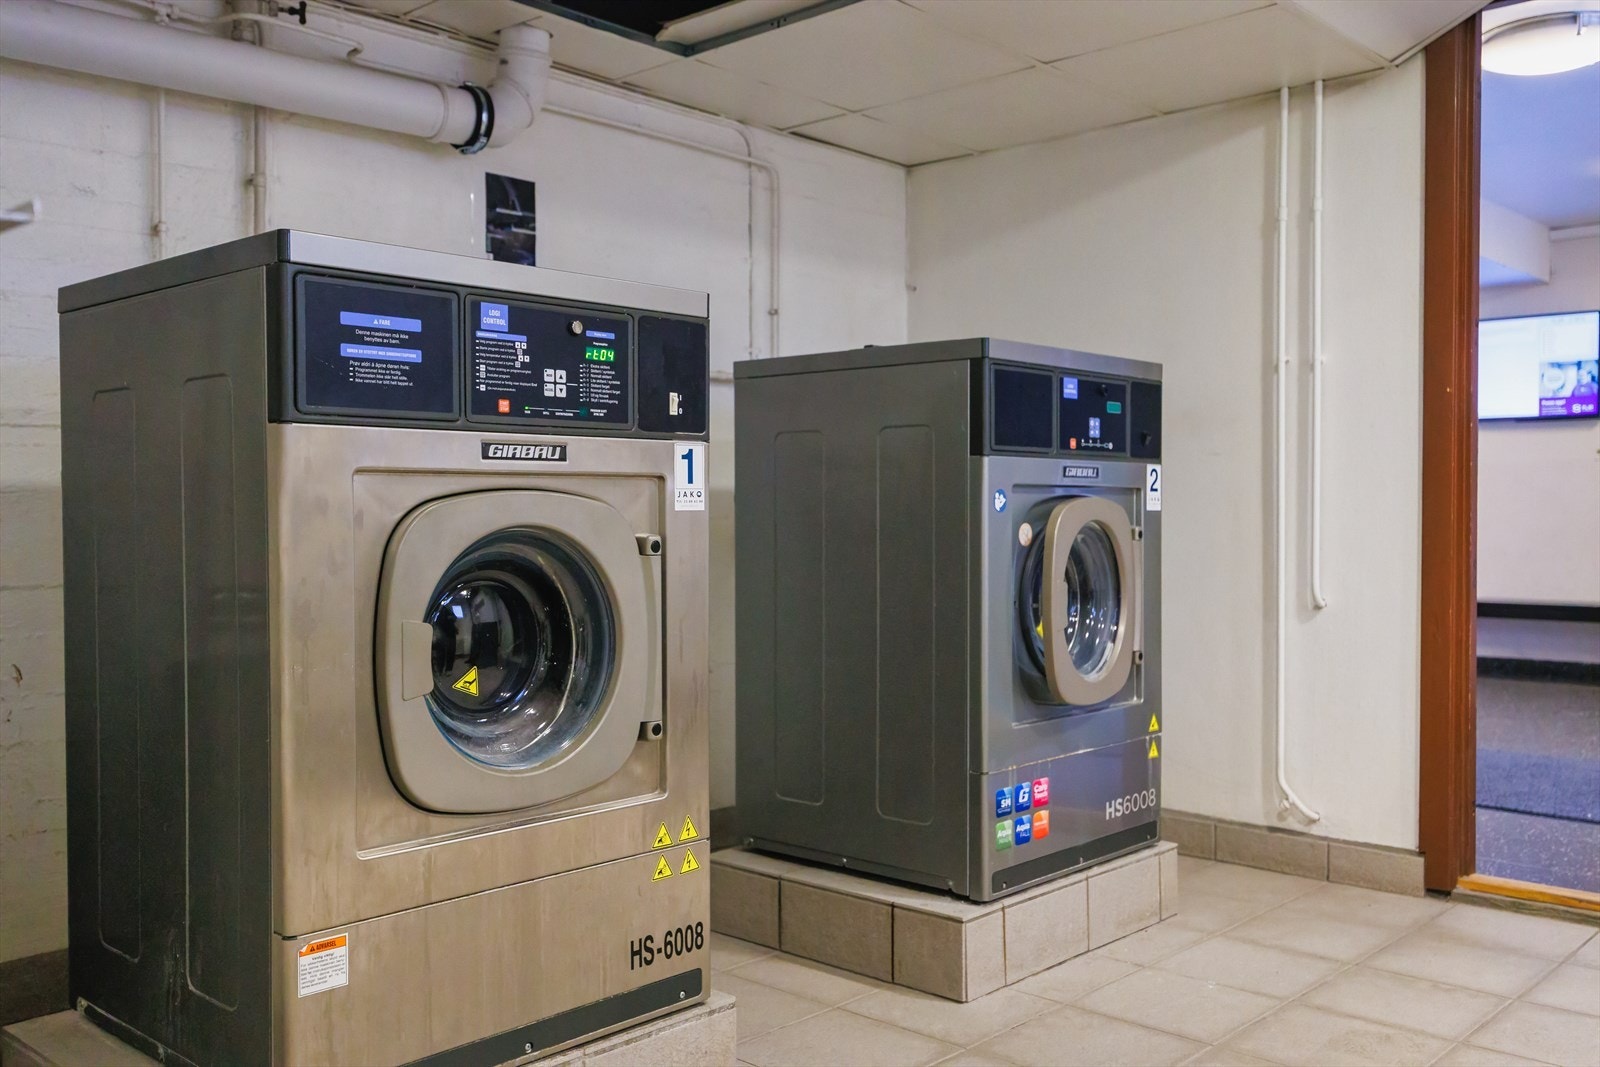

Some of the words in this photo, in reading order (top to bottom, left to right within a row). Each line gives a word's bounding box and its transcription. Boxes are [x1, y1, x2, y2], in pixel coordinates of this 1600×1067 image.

[483, 317, 506, 325] CONTROL
[488, 444, 560, 459] GIRBAU
[681, 449, 693, 484] 1
[1150, 468, 1158, 492] 2
[1106, 788, 1156, 820] HS6008
[316, 941, 336, 950] ADVARSEL
[631, 922, 704, 970] HS-6008
